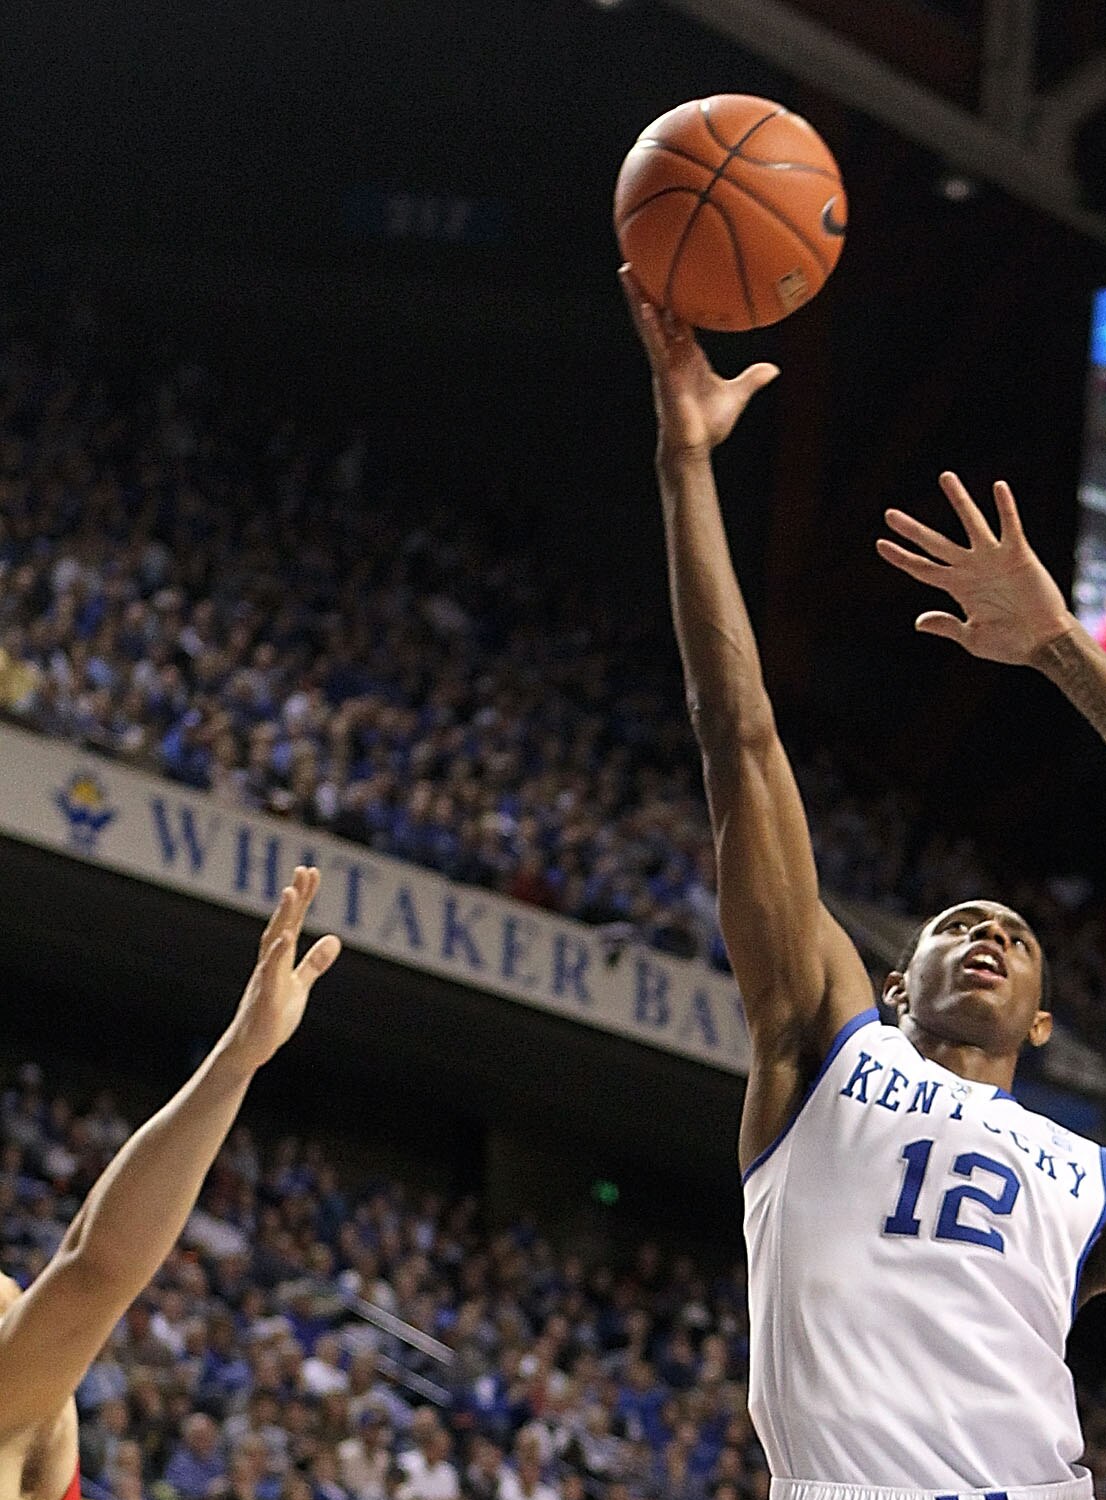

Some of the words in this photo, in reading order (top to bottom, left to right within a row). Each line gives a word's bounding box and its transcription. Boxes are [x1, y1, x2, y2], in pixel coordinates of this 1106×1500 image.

[151, 796, 592, 1002] WHTAKER
[634, 957, 750, 1048] BA
[880, 1138, 1021, 1254] 12
